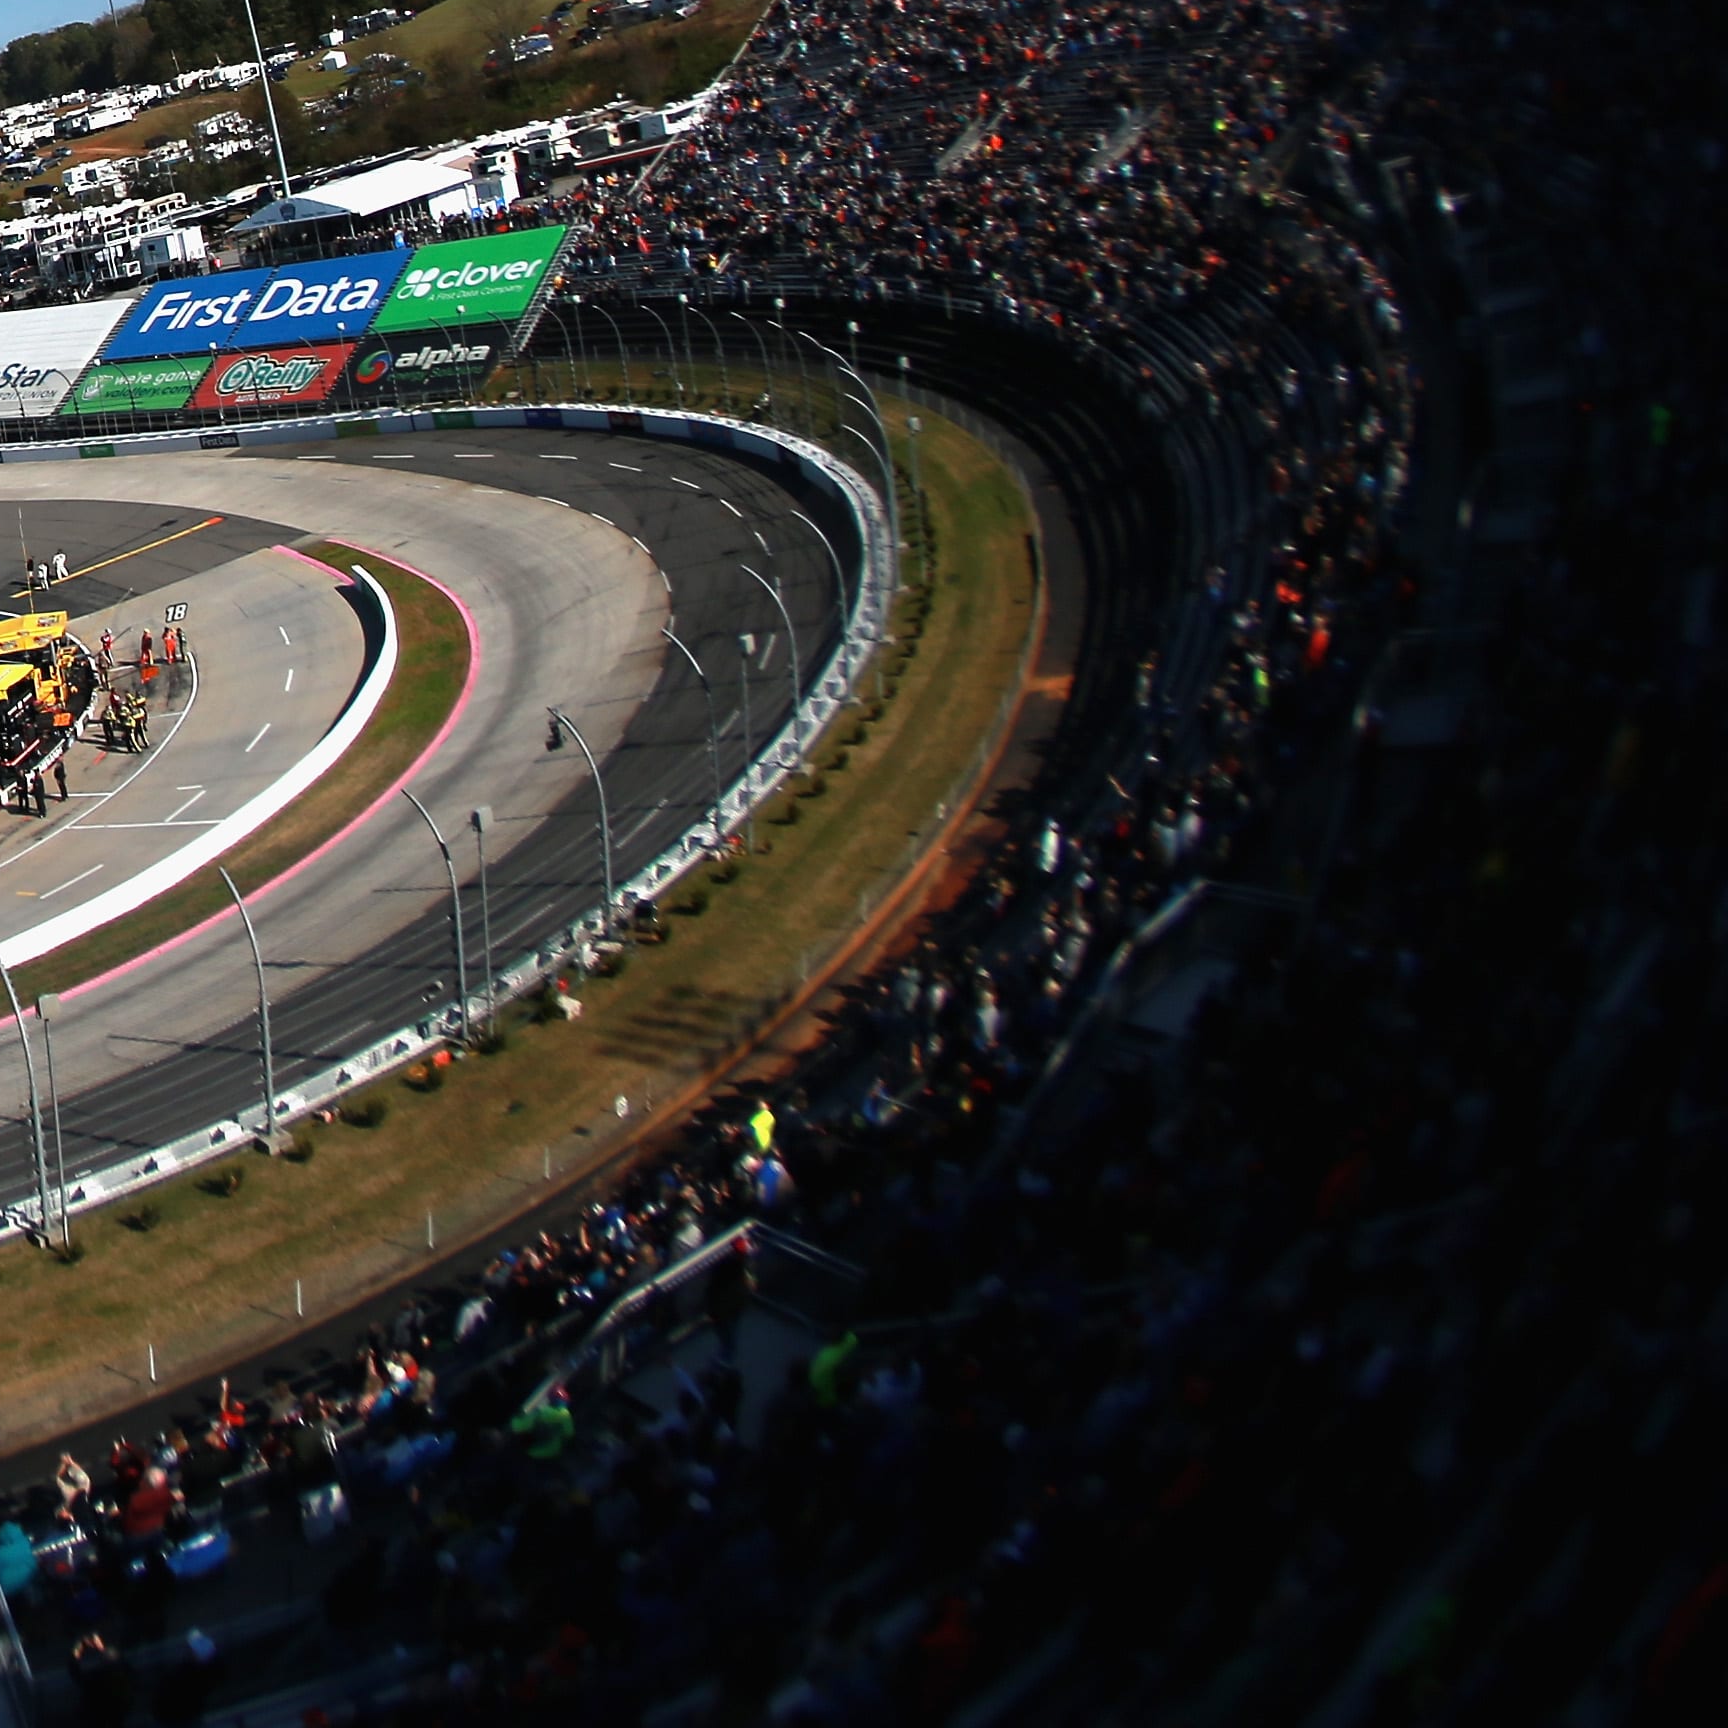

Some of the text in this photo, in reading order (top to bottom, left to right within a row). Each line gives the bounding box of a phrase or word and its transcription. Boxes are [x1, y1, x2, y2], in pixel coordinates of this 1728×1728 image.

[437, 258, 543, 289] clover
[456, 289, 479, 299] Data
[480, 284, 524, 296] Company
[139, 289, 253, 333] First
[395, 343, 491, 371] alpha
[155, 368, 202, 387] game
[218, 354, 328, 396] O'Reilly
[21, 389, 58, 401] UNION
[165, 602, 189, 623] 18
